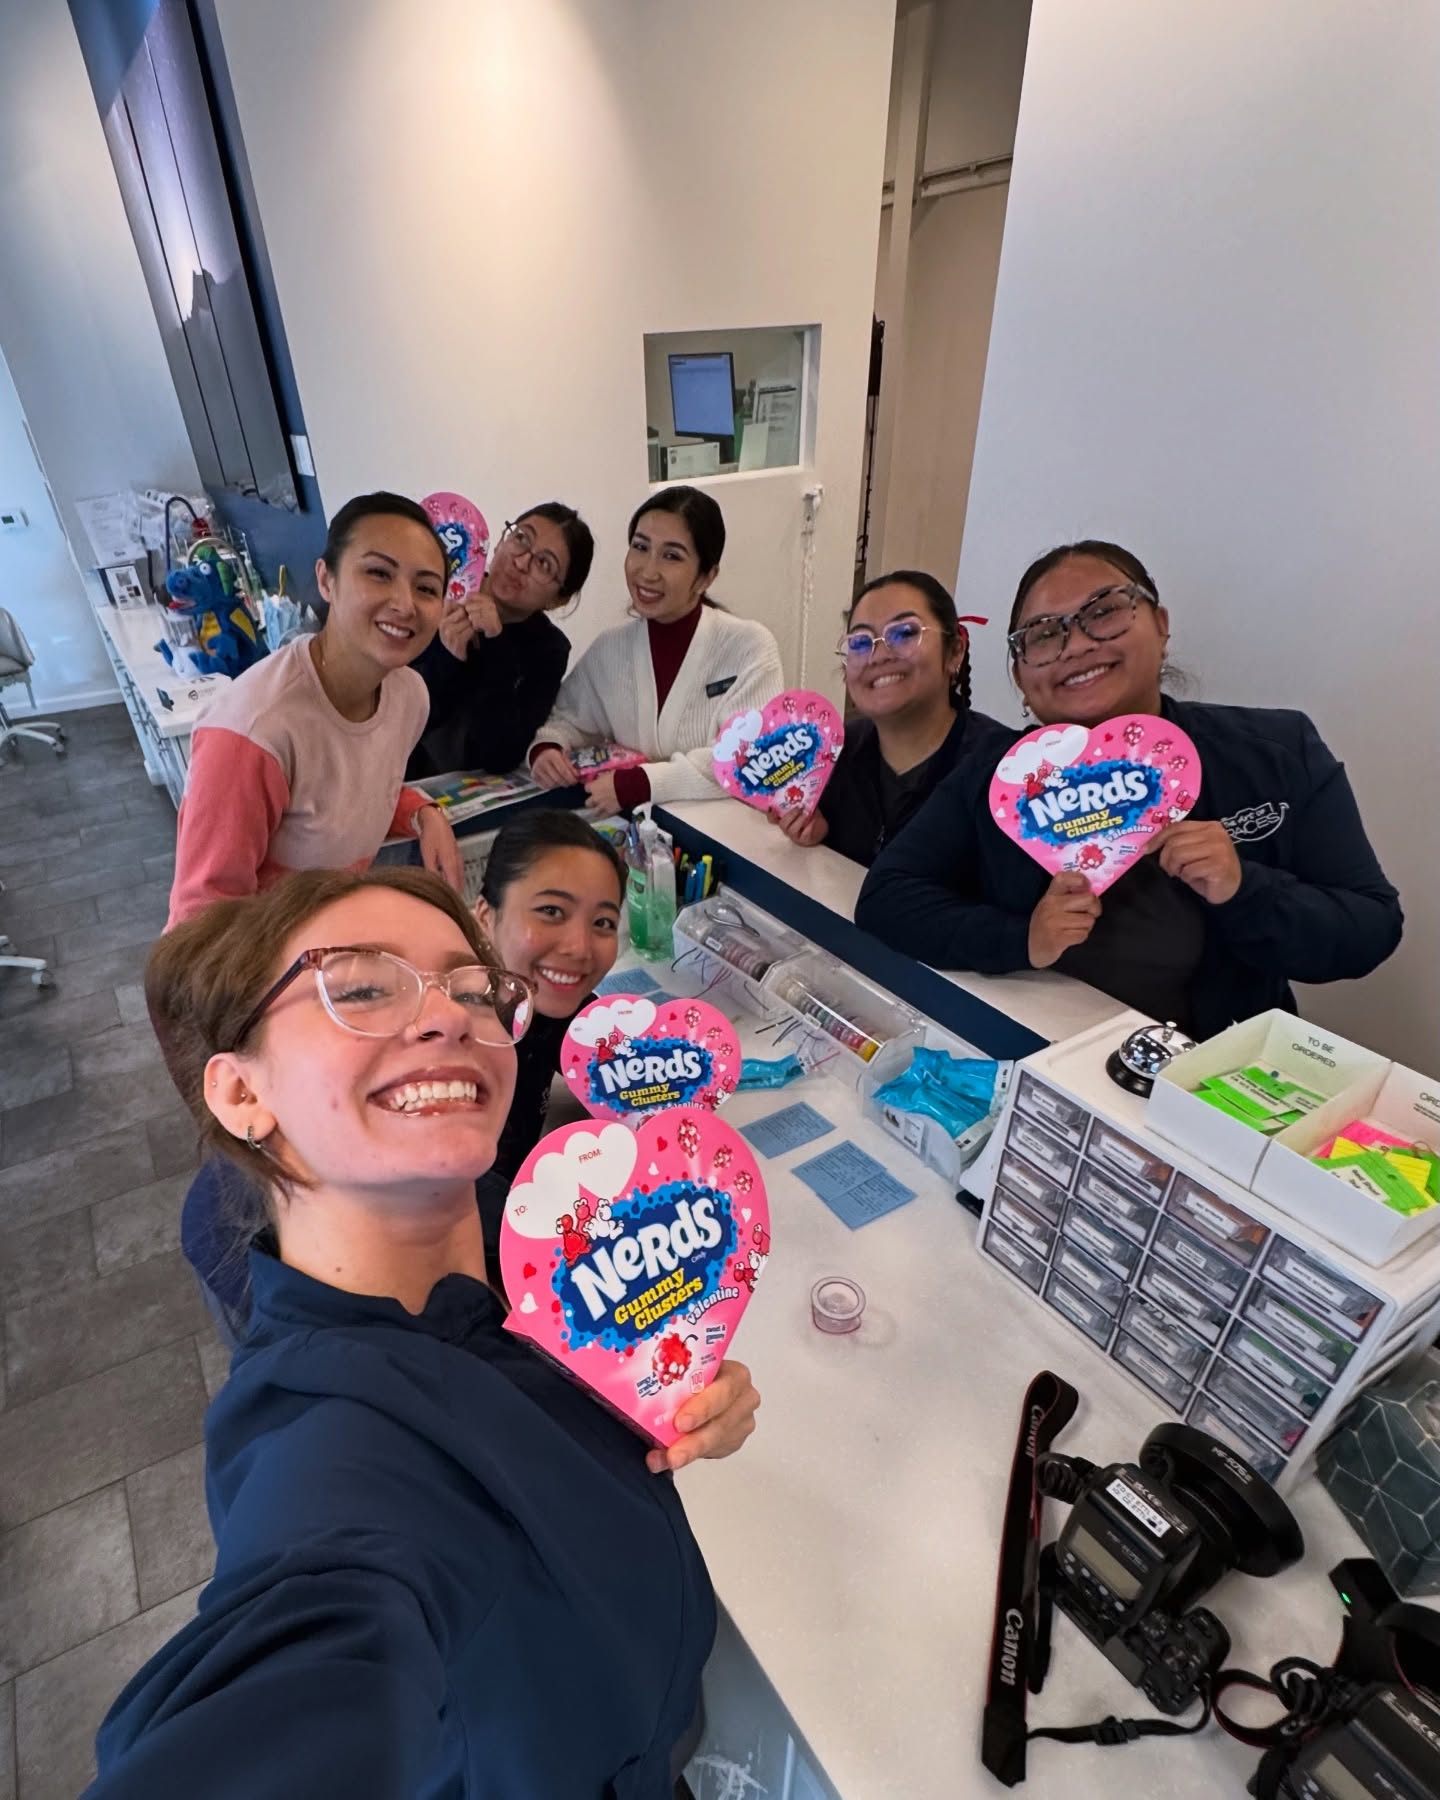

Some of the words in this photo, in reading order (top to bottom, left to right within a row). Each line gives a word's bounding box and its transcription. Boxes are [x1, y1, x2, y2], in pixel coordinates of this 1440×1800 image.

[1053, 809, 1109, 833] Gummy
[1066, 814, 1124, 838] Clusters
[1292, 1043, 1336, 1068] ORDERED
[1307, 1036, 1320, 1047] TO
[1321, 1043, 1335, 1053] BE
[619, 1084, 670, 1101] Gummy
[631, 1090, 681, 1107] Clusters
[578, 1149, 603, 1164] FROM:
[513, 1204, 529, 1217] TO:
[614, 1267, 686, 1326] Gummy
[634, 1276, 704, 1331] Clusters
[1000, 1608, 1024, 1686] Canon
